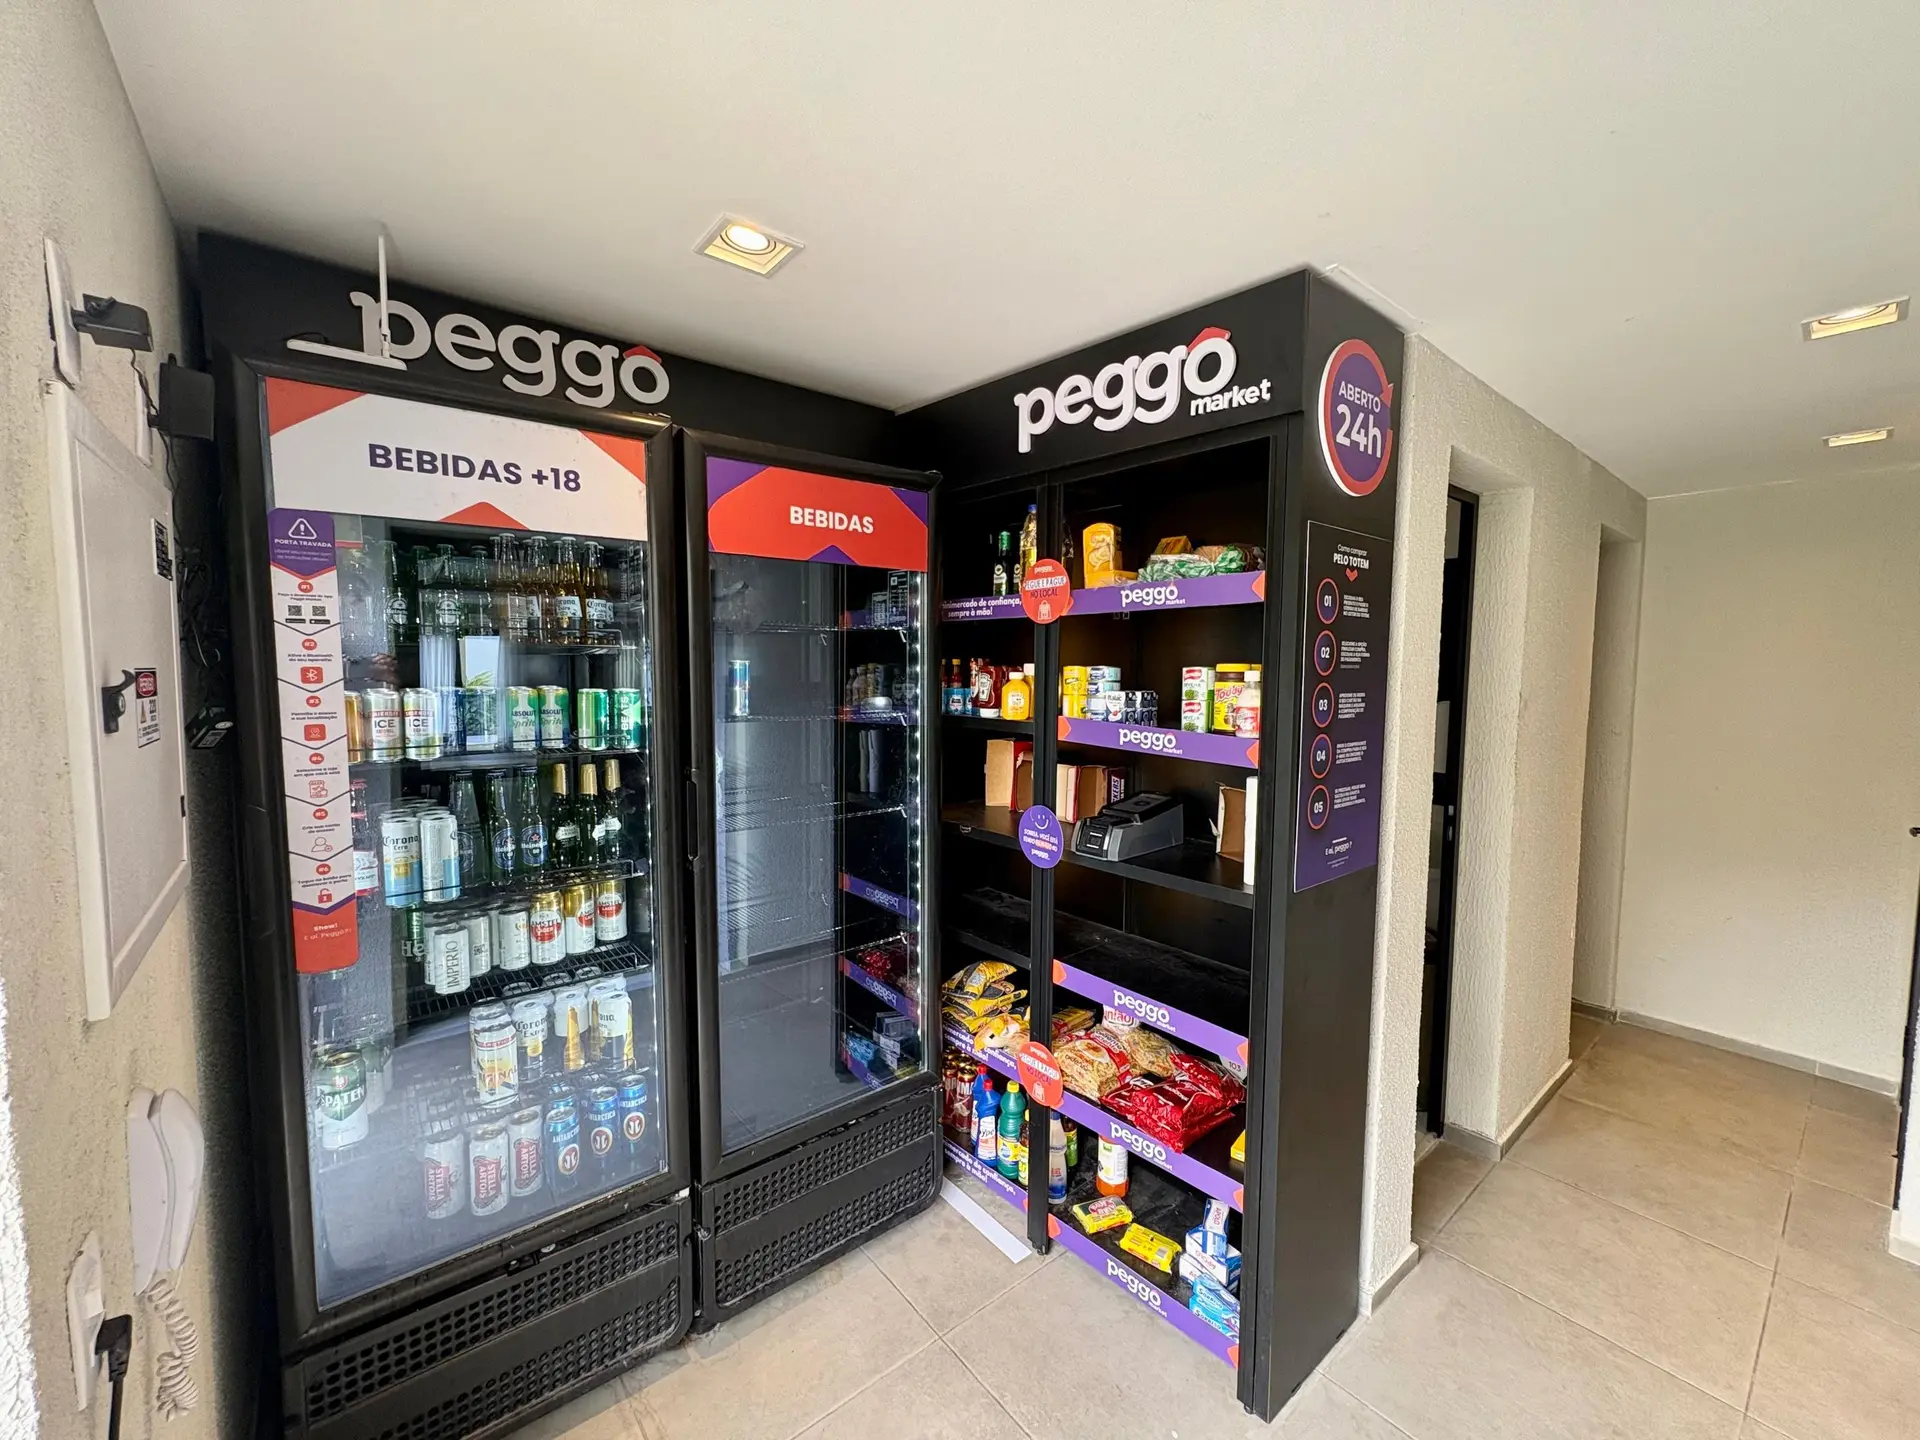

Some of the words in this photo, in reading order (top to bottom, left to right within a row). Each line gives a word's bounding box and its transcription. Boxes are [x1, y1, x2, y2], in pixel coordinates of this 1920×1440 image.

[1190, 378, 1271, 416] market
[1338, 380, 1381, 413] ABERTO
[1335, 403, 1381, 459] 24h
[368, 443, 523, 485] BEBIDAS
[531, 467, 581, 493] +18
[789, 505, 874, 534] BEBIDAS
[274, 538, 298, 546] PORTA
[299, 540, 332, 548] TRAVADA
[1337, 544, 1350, 553] Como
[1350, 548, 1367, 557] comprar
[1333, 553, 1348, 565] PELO
[1349, 556, 1369, 569] TOTEM
[979, 598, 986, 606] de
[988, 596, 1022, 607] confiança,
[1323, 595, 1332, 607] 01
[948, 610, 970, 618] sempre
[976, 607, 993, 616] mão!
[1320, 646, 1330, 659] 02
[1215, 684, 1243, 699] Toddy
[1318, 699, 1328, 711] 03
[374, 719, 395, 729] ICE
[408, 718, 429, 728] ICE
[1316, 750, 1326, 762] 04
[1313, 802, 1323, 813] 05
[383, 835, 418, 846] Corona
[313, 923, 338, 932] Show!
[1228, 1060, 1242, 1072] 103
[320, 1085, 365, 1108] SPATEN
[521, 1148, 529, 1179] ARTOIS
[528, 1144, 537, 1177] STELLA
[436, 1168, 444, 1200] STELLA
[479, 1166, 487, 1198] ARTOIS
[487, 1163, 496, 1197] STELLA
